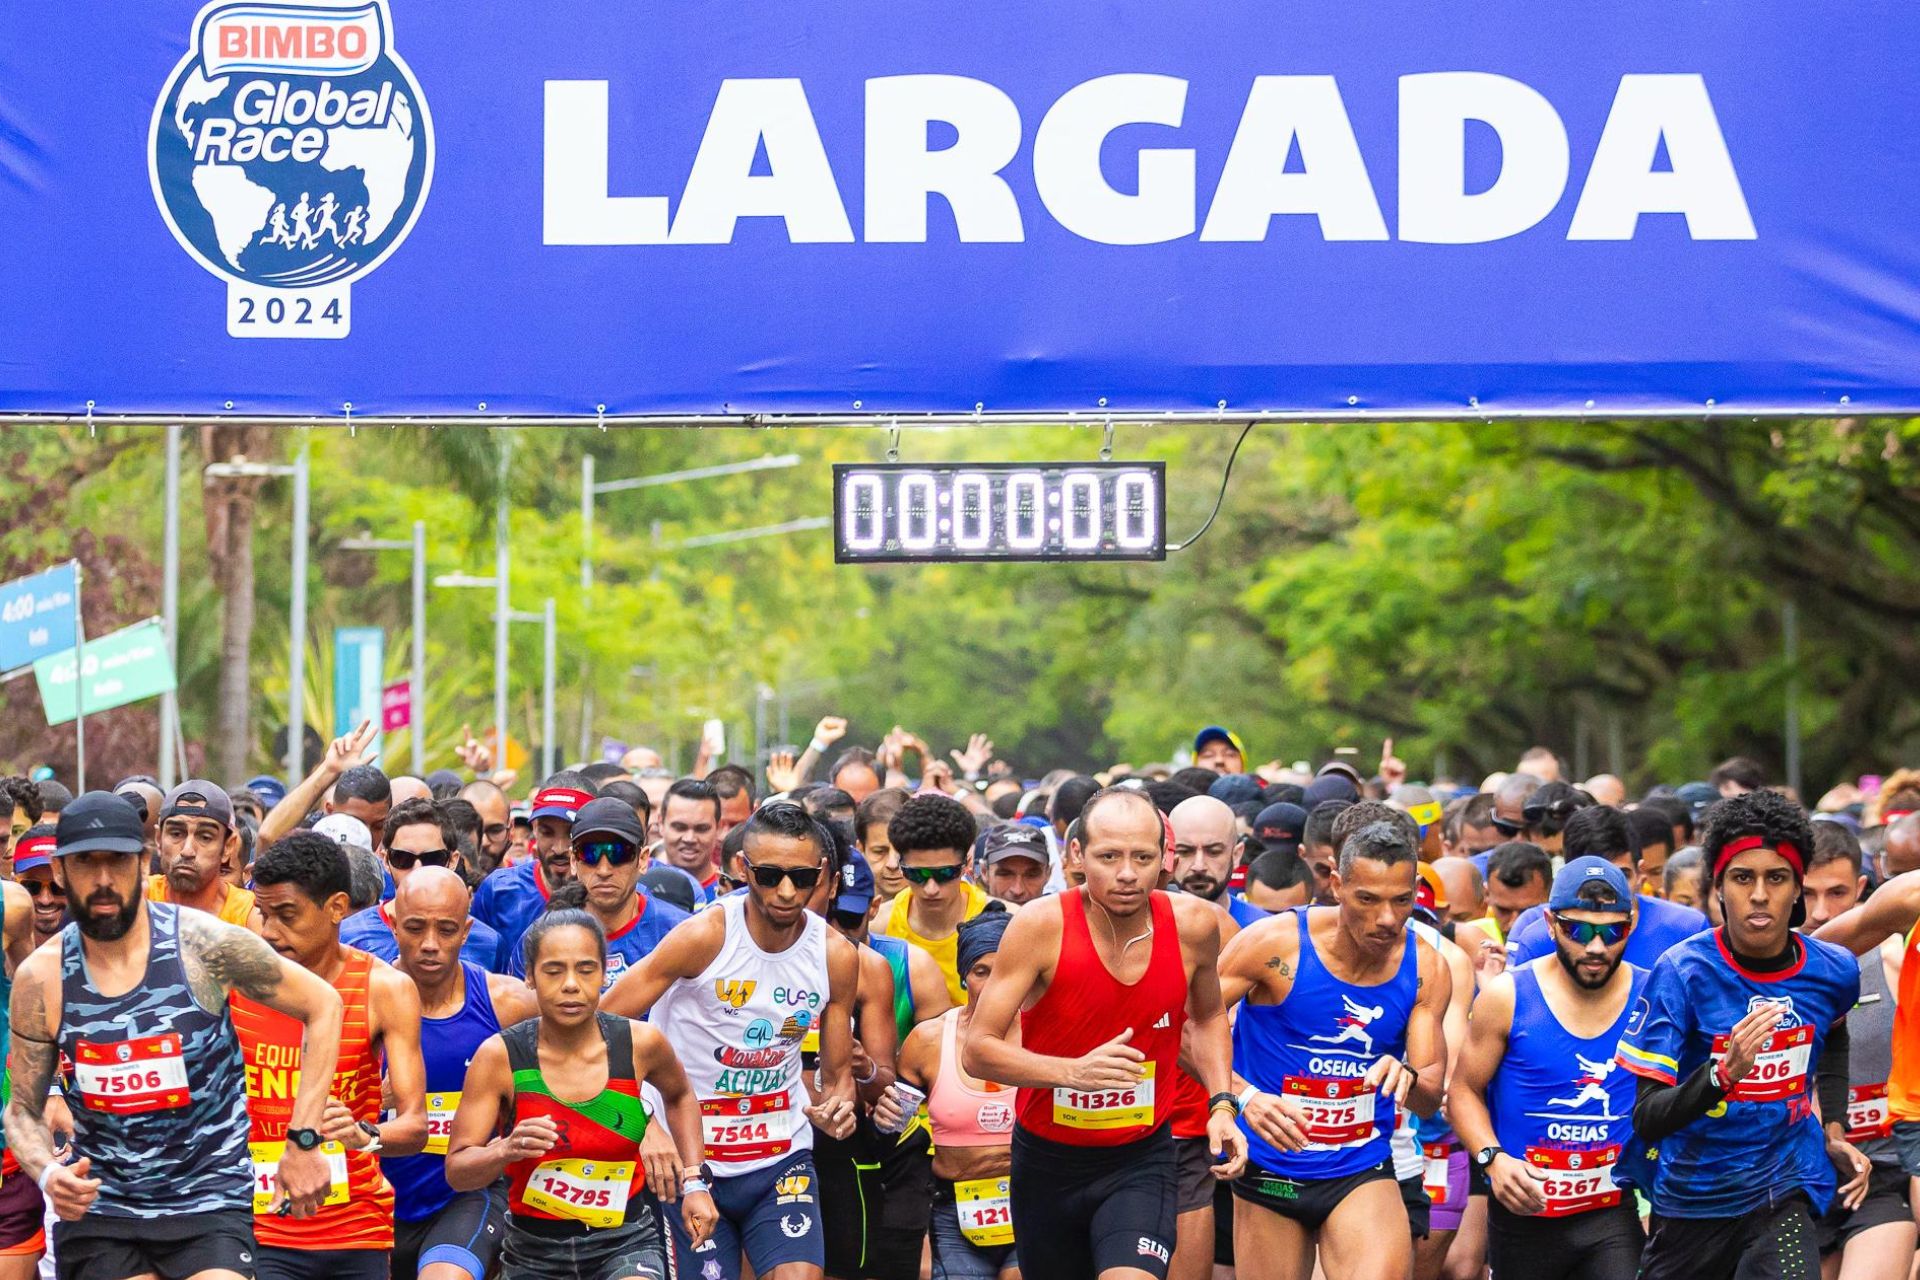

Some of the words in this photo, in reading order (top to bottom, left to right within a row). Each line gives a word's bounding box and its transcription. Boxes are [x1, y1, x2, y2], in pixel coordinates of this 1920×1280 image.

[219, 25, 367, 59] BIMBO
[233, 80, 393, 125] Global
[194, 118, 325, 162] Race
[543, 71, 1758, 246] LARGADA
[238, 297, 343, 324] 2024
[845, 473, 1155, 551] 00:00:00
[255, 1042, 301, 1069] EQUI
[1308, 1056, 1368, 1078] OSEIAS
[95, 1070, 161, 1093] 7506
[1068, 1090, 1136, 1110] 11326
[1847, 1108, 1881, 1126] 59
[711, 1122, 769, 1143] 7544
[1547, 1122, 1609, 1143] OSEIAS
[543, 1177, 611, 1208] 12795
[1542, 1176, 1602, 1197] 6267
[1136, 1236, 1169, 1266] SUB
